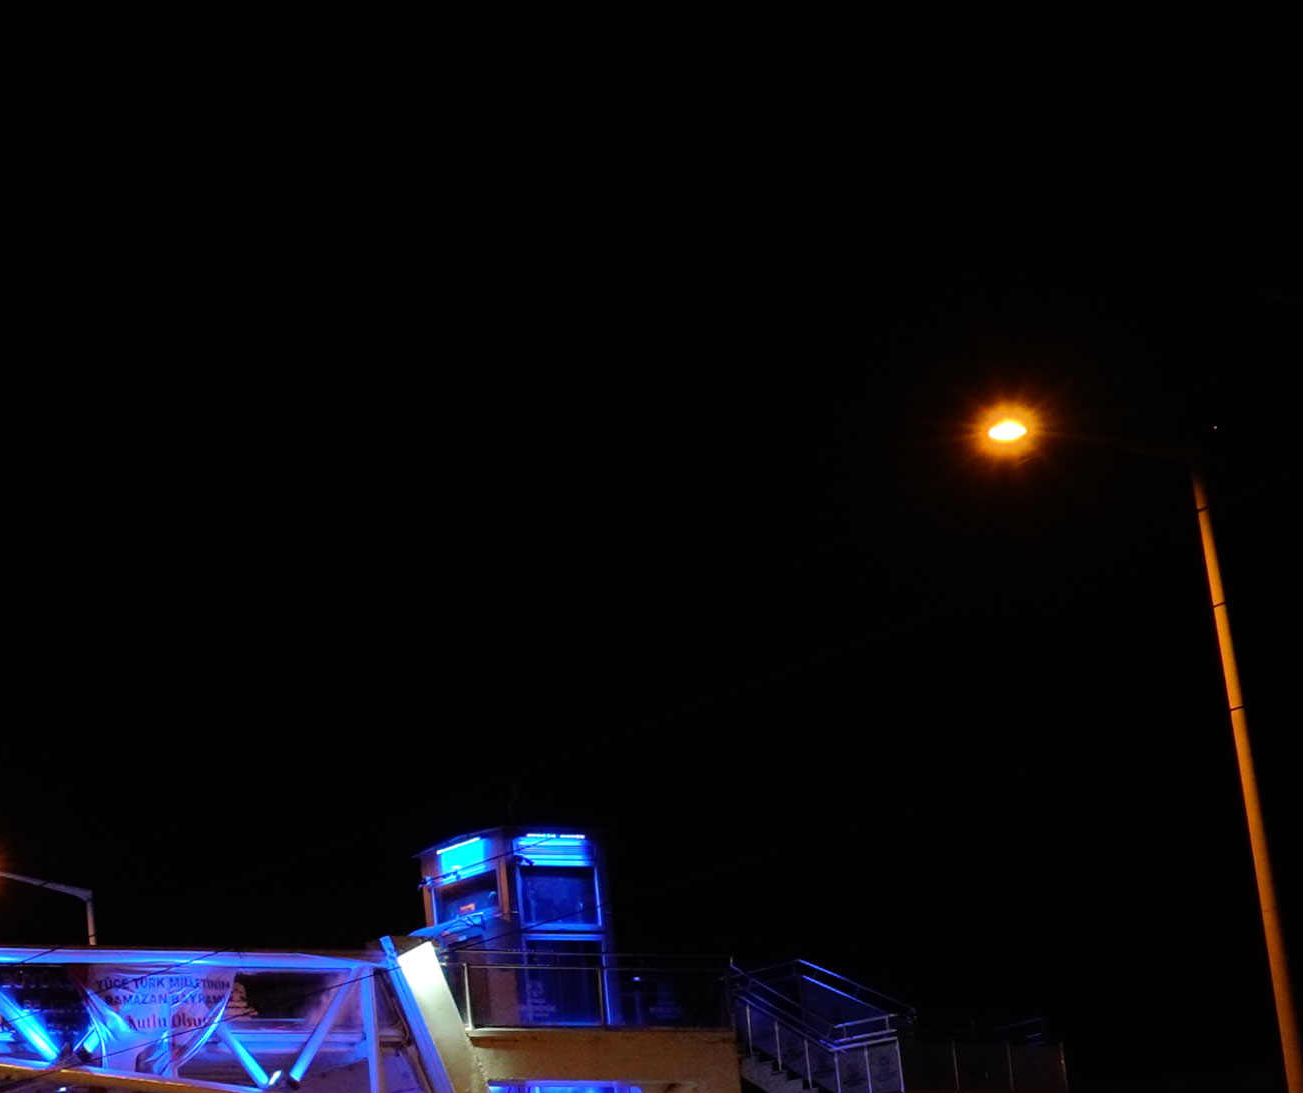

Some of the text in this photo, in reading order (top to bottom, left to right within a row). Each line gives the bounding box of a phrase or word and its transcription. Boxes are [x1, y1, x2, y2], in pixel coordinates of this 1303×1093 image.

[96, 977, 129, 989] YÜCE
[134, 977, 165, 989] TÜRK
[105, 993, 225, 1006] RAMAZAN BAYRAM
[125, 1013, 206, 1030] Kutlu Olsu
